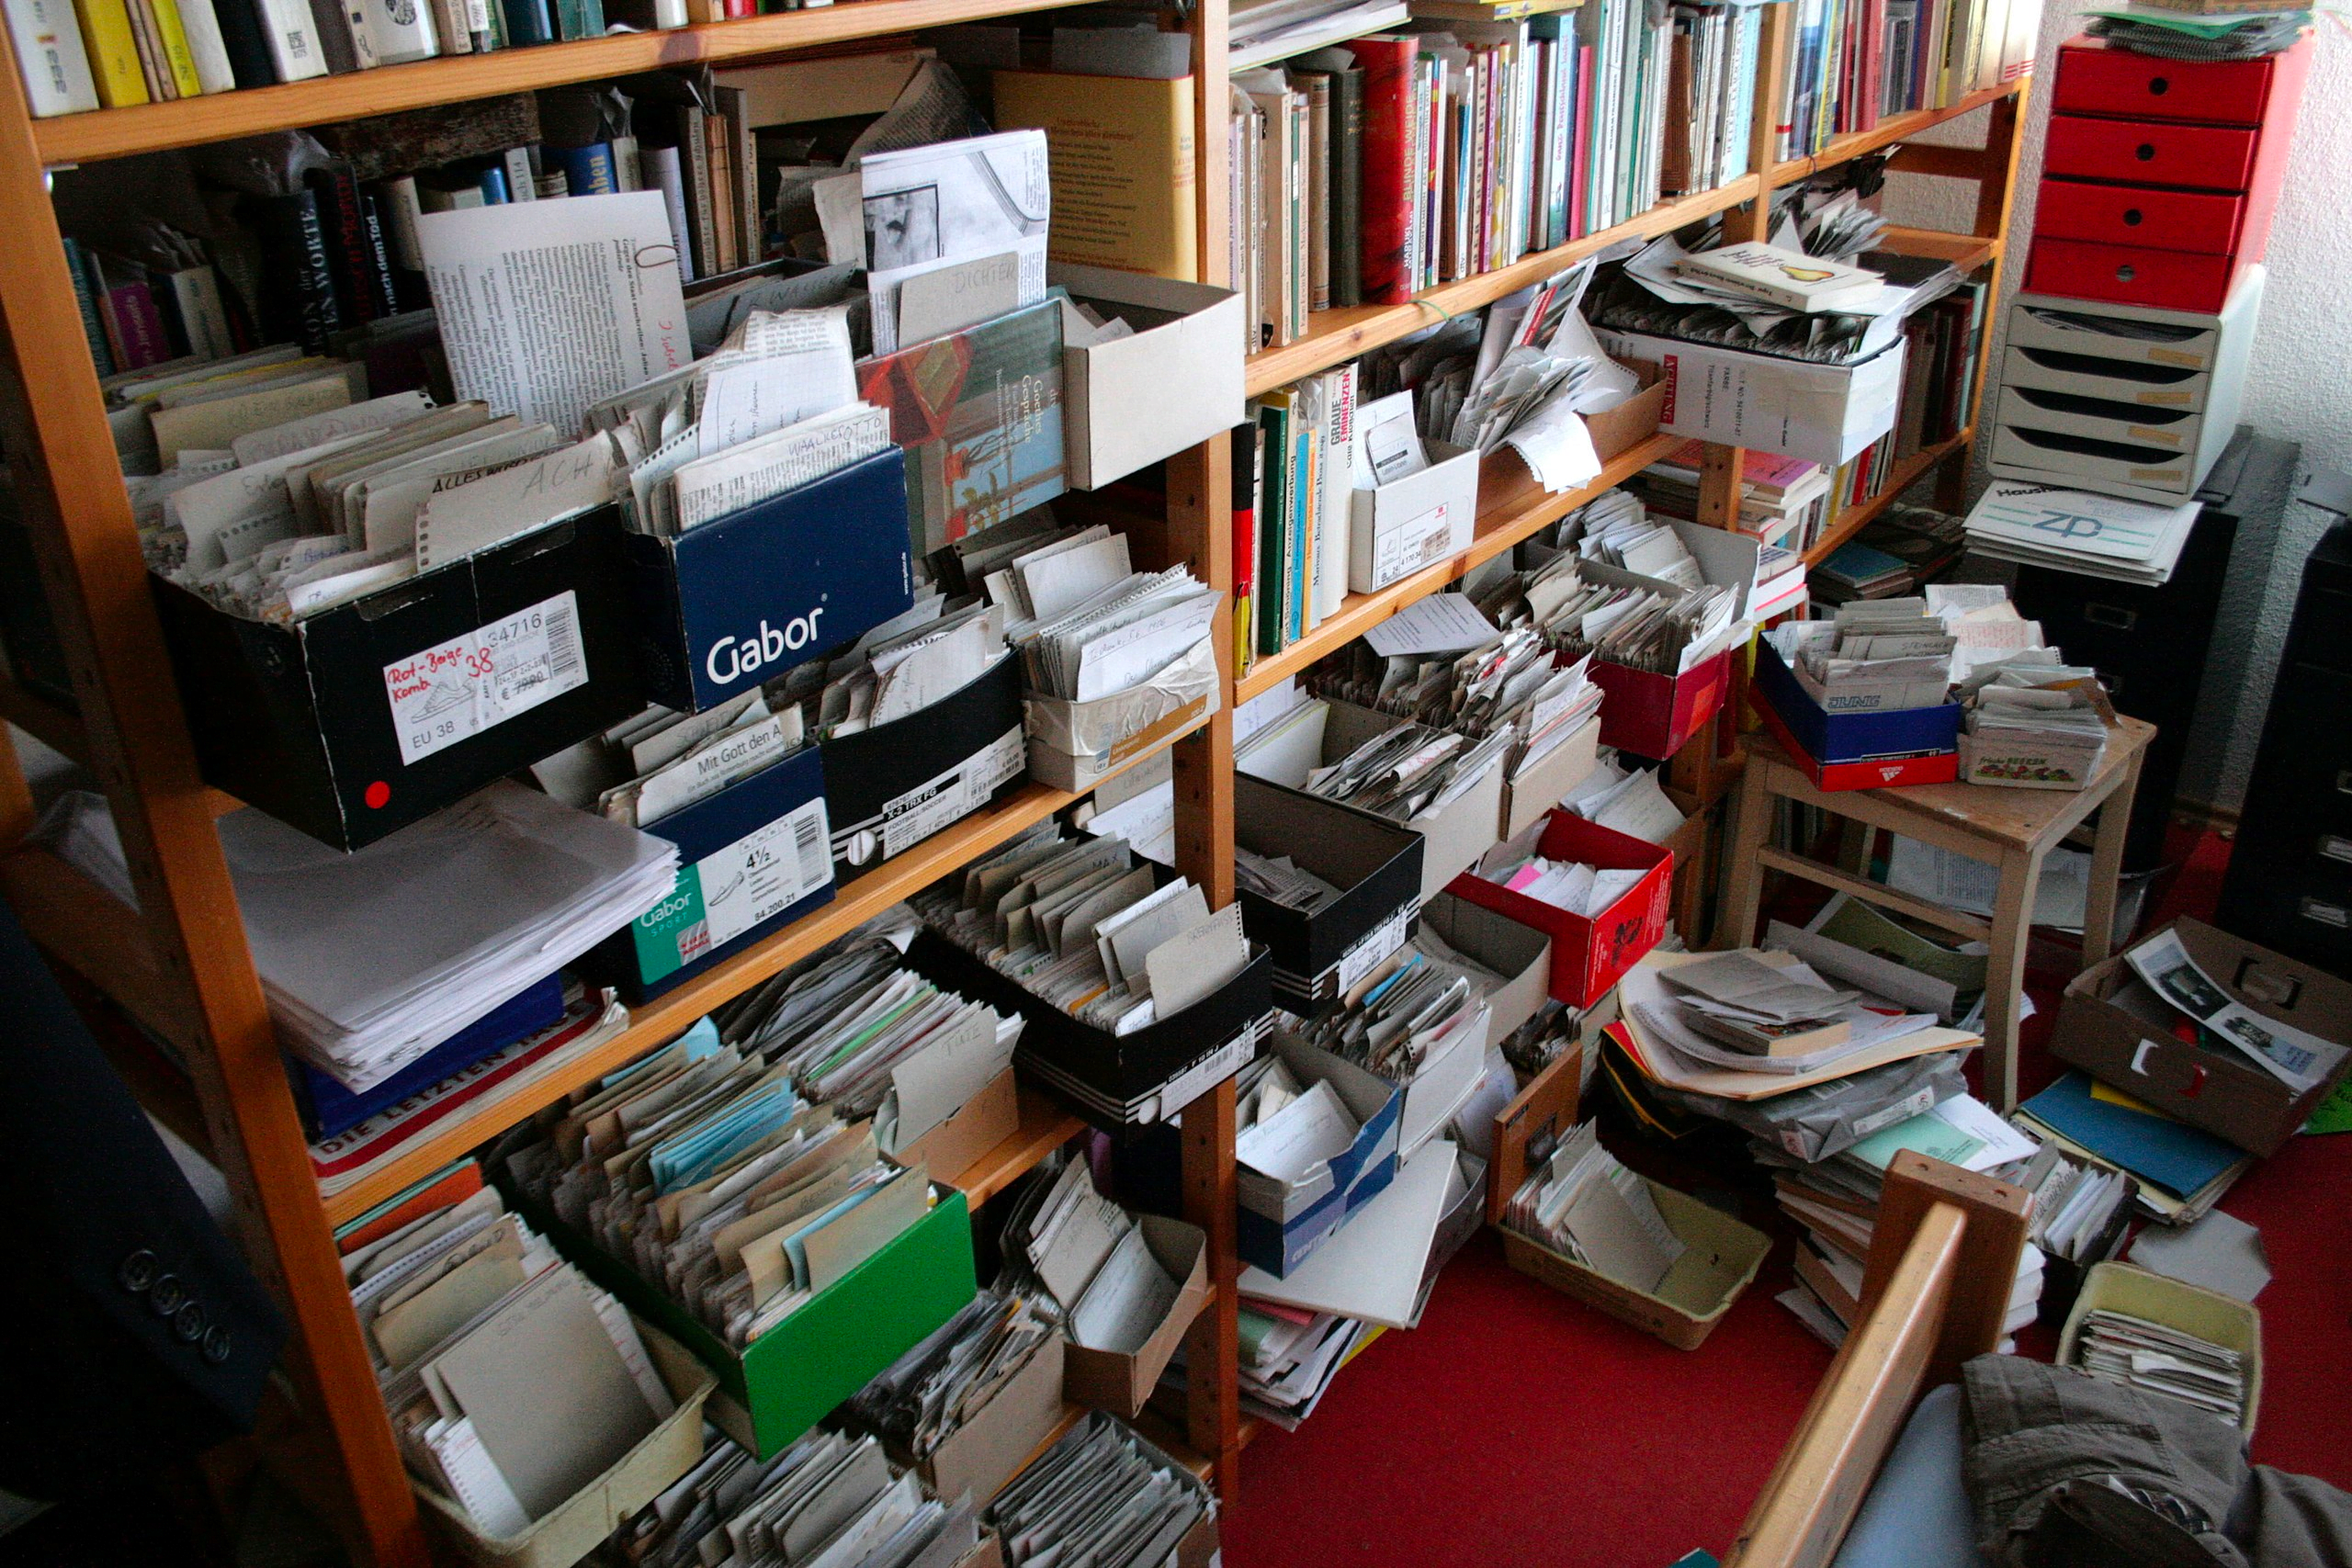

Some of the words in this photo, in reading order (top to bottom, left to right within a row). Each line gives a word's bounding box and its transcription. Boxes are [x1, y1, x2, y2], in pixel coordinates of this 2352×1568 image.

[1404, 95, 1414, 143] WEIDE
[1402, 146, 1412, 201] BLINDE
[373, 244, 389, 274] dem
[380, 274, 396, 306] nach
[621, 238, 631, 263] Gegen
[628, 280, 637, 300] Staat
[640, 352, 650, 375] Julian
[1033, 379, 1044, 434] Goethes
[1340, 373, 1351, 442] EMINENZEN
[1663, 355, 1677, 423] ACHTUNG
[1331, 400, 1342, 446] GRAUE
[432, 469, 485, 495] ALLES
[1285, 455, 1295, 558] Anzeigenwerbung
[1283, 566, 1292, 618] Schöning
[487, 614, 542, 648] 34716
[707, 607, 823, 685] Gabor
[466, 647, 494, 678] 38
[413, 729, 431, 750] EU
[437, 720, 456, 739] 38
[698, 754, 719, 776] Mit
[720, 741, 751, 767] Gott
[749, 730, 775, 755] den
[773, 723, 783, 742] A
[886, 806, 906, 819] X-2
[904, 795, 925, 812] TRX
[922, 786, 938, 801] FG
[640, 893, 693, 930] Gabor
[650, 913, 688, 938] SPORT
[320, 1122, 373, 1156] DIE
[386, 1051, 510, 1134] LETZTEN
